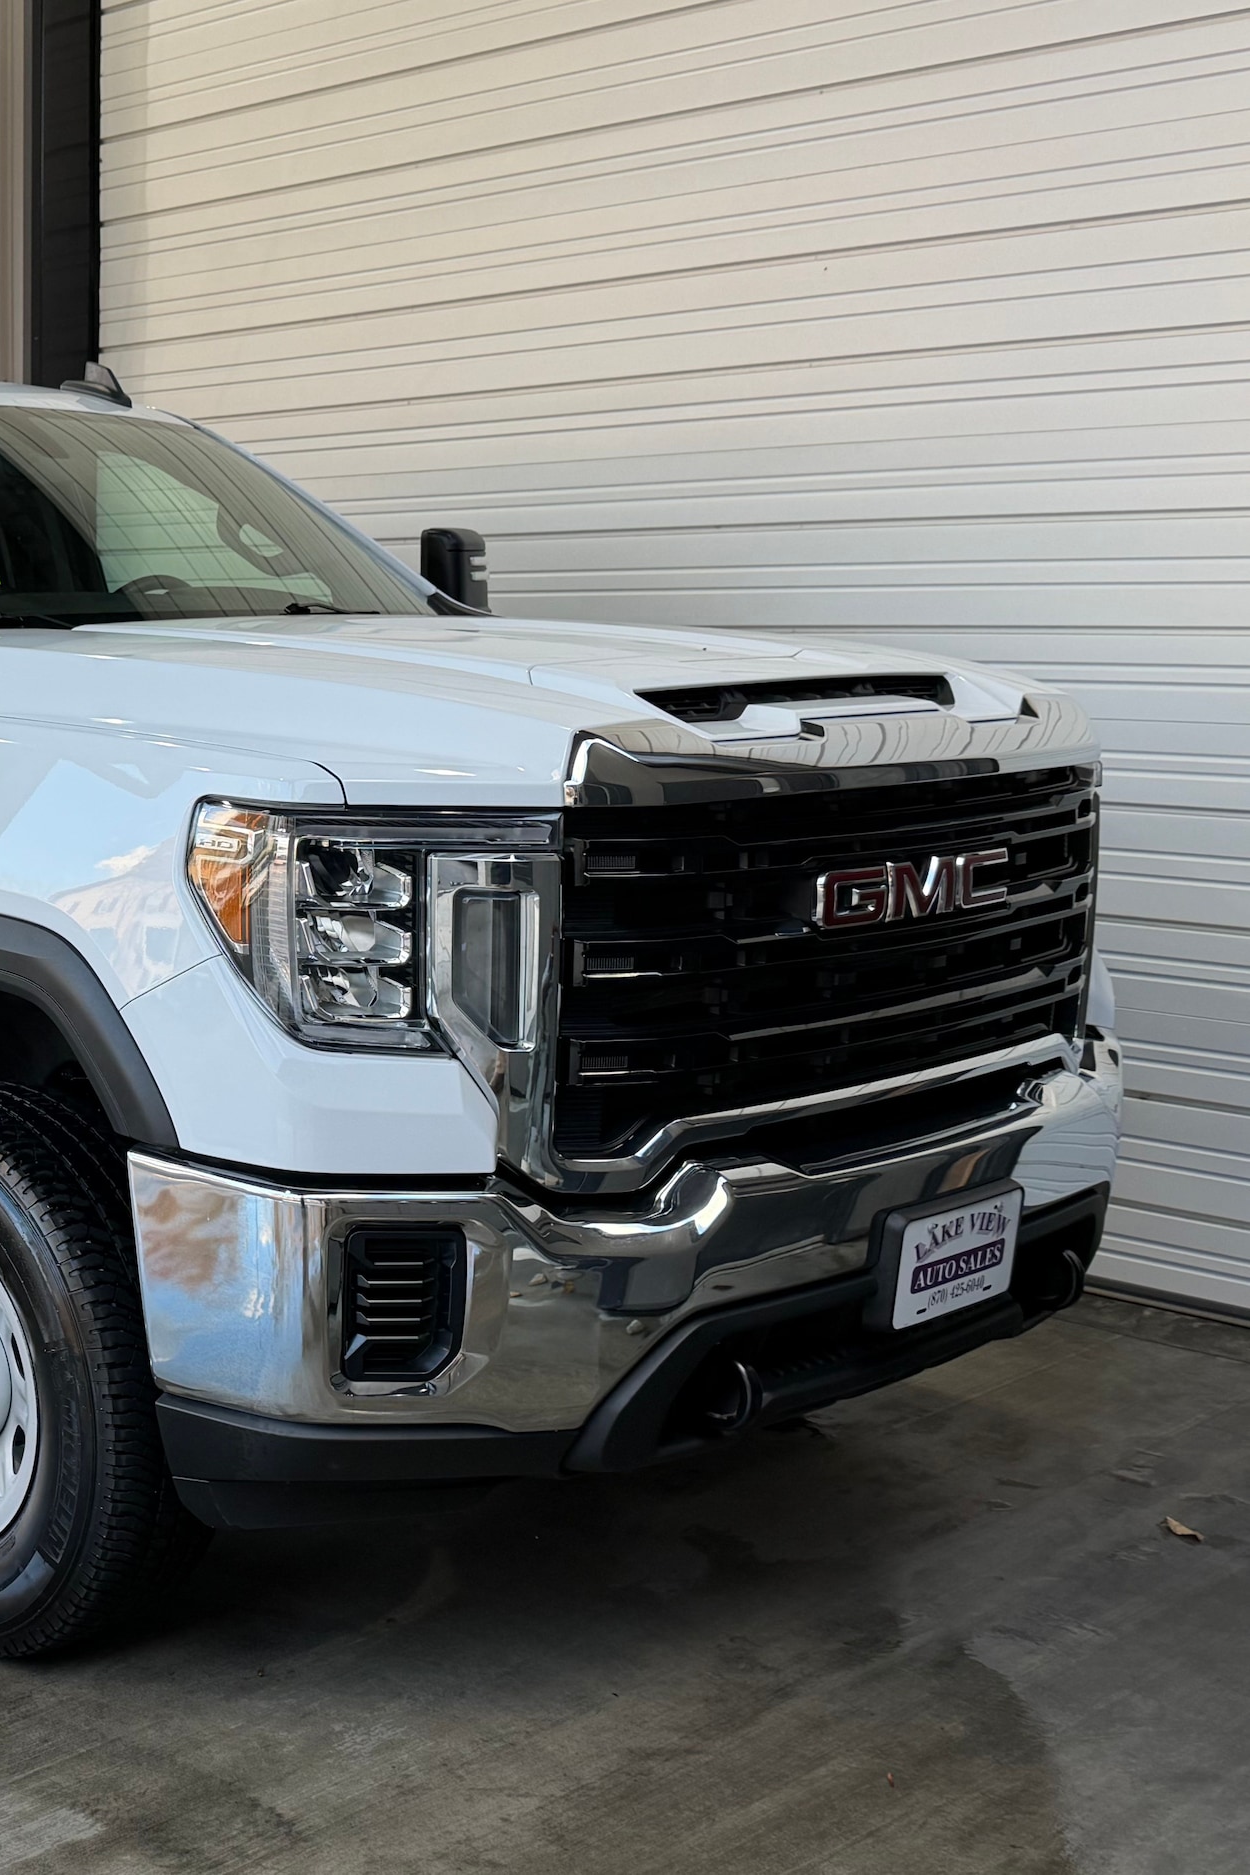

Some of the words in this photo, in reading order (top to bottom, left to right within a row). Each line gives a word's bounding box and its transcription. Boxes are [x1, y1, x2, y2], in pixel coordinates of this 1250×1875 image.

[815, 847, 1009, 930] GMC
[913, 1216, 965, 1263] LAKE
[970, 1212, 1011, 1237] VIEW
[913, 1259, 956, 1291] AUTO
[958, 1243, 1002, 1275] SALES
